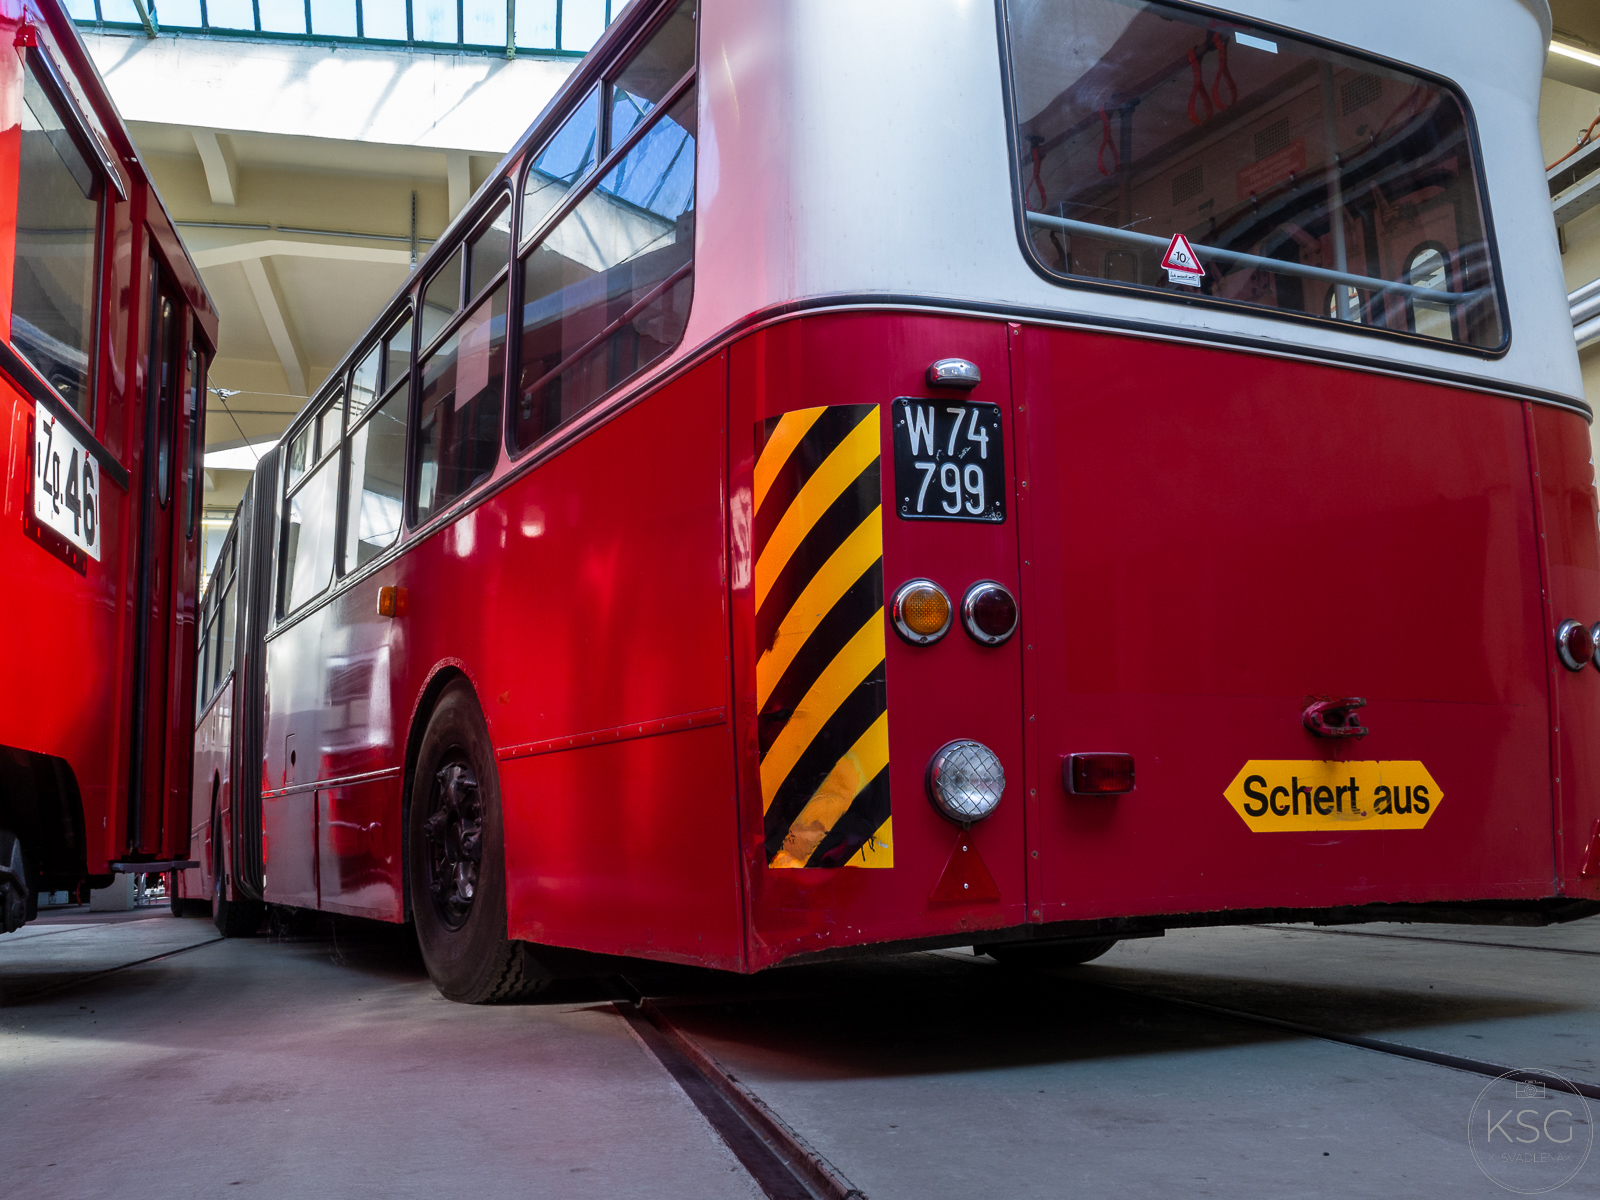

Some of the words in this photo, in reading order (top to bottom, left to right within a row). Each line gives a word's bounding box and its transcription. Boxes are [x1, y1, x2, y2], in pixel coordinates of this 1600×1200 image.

[905, 405, 935, 456] W
[946, 406, 989, 459] 74
[914, 462, 985, 515] 799
[1243, 775, 1361, 817] Schert
[1373, 785, 1430, 815] aus
